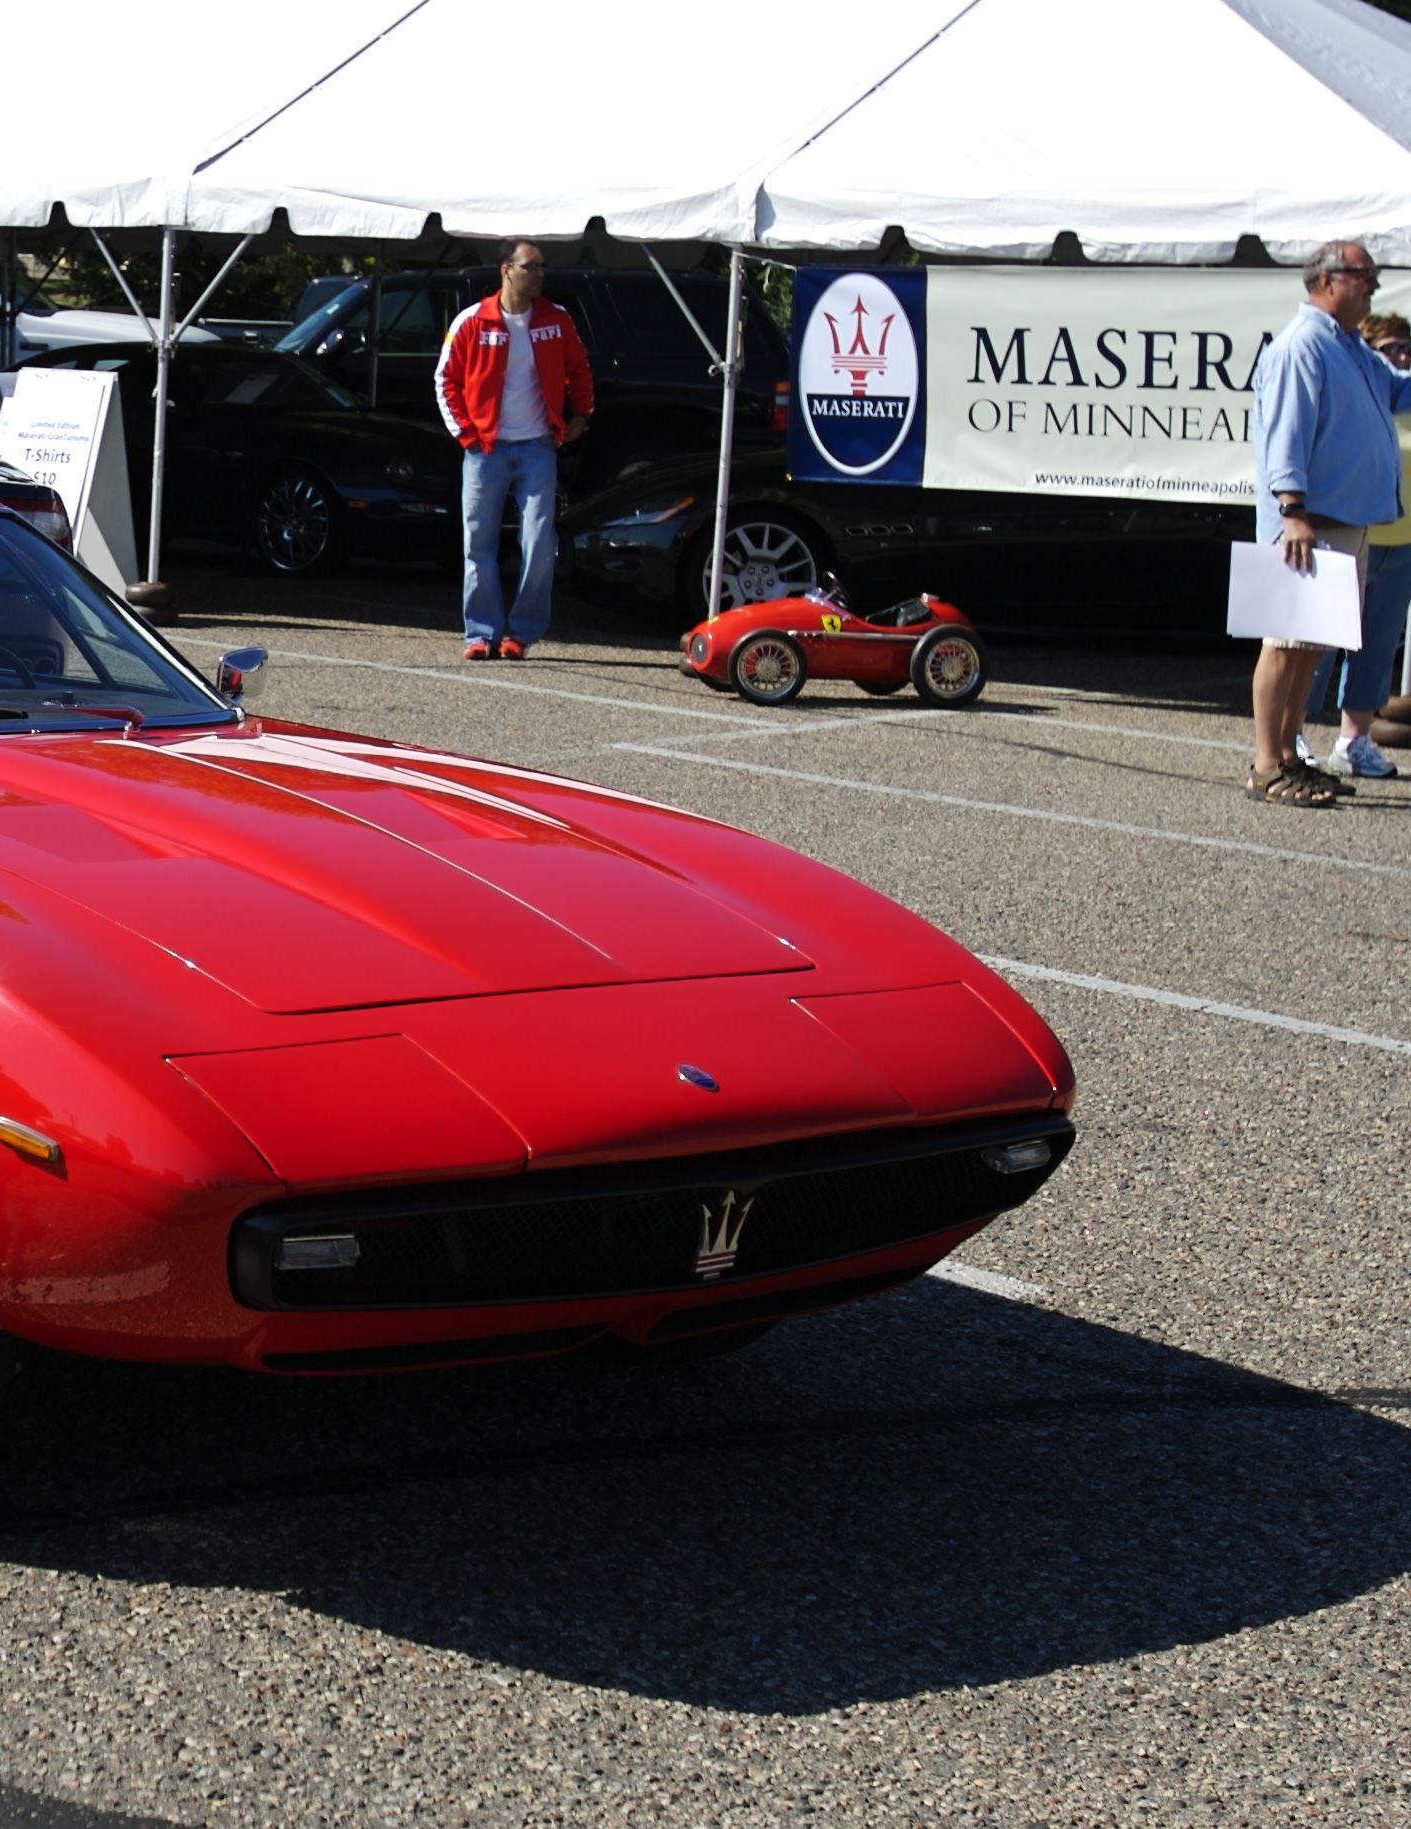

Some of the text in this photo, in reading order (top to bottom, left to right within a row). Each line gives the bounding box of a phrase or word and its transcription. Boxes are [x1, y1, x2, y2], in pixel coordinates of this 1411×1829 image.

[811, 399, 904, 418] MASERATI
[968, 398, 1027, 433] OF
[31, 421, 81, 430] Limited Edition
[25, 447, 72, 464] T-Shirts
[33, 470, 57, 486] $10
